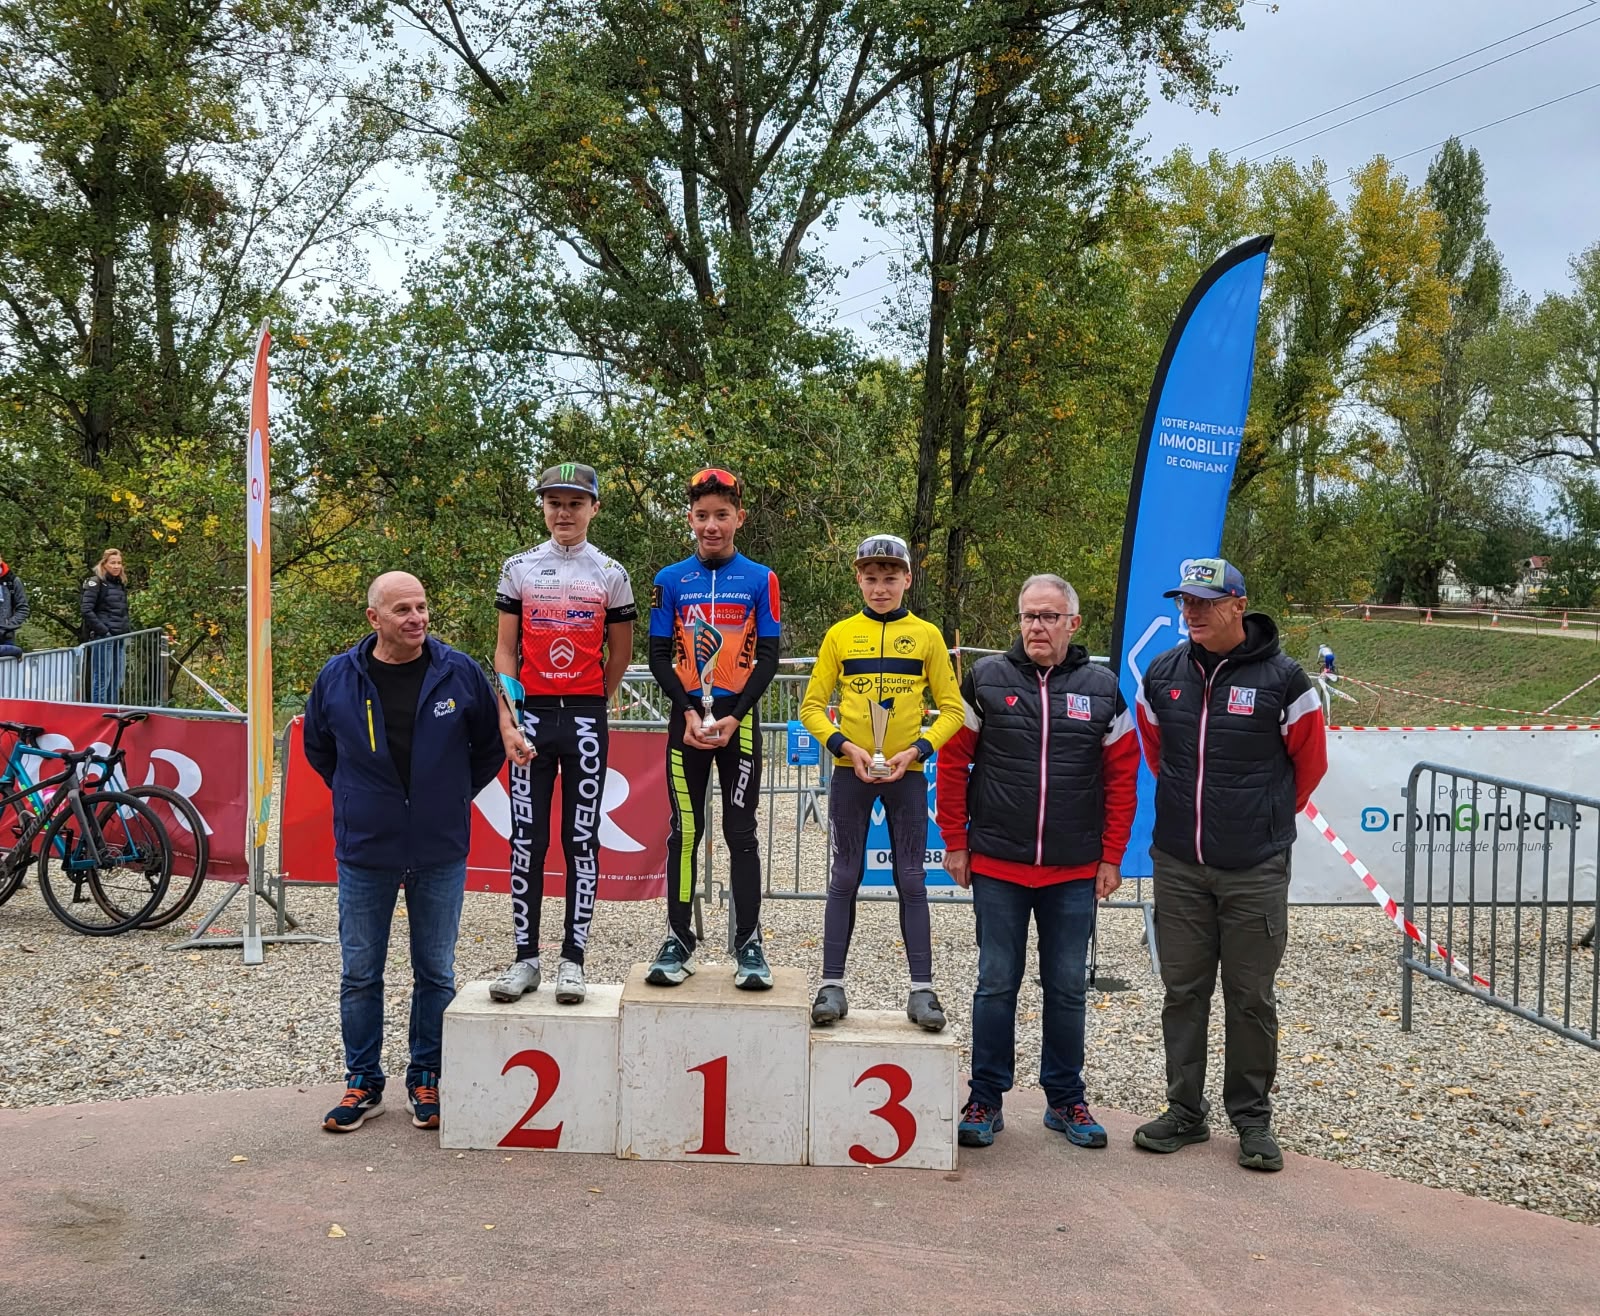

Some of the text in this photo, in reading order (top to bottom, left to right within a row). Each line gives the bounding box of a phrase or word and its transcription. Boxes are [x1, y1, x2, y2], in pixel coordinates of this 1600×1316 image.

[1161, 416, 1188, 430] VOTRE
[1166, 455, 1179, 467] DE
[539, 609, 595, 619] INTERSPORT
[875, 676, 915, 685] Escudero
[875, 686, 914, 694] TOYOTA
[733, 758, 752, 809] poli
[1438, 784, 1508, 800] Porte de
[1474, 840, 1490, 852] de
[625, 873, 637, 881] des
[497, 1050, 564, 1149] 2
[685, 1055, 740, 1156] 1
[848, 1063, 917, 1165] 3
